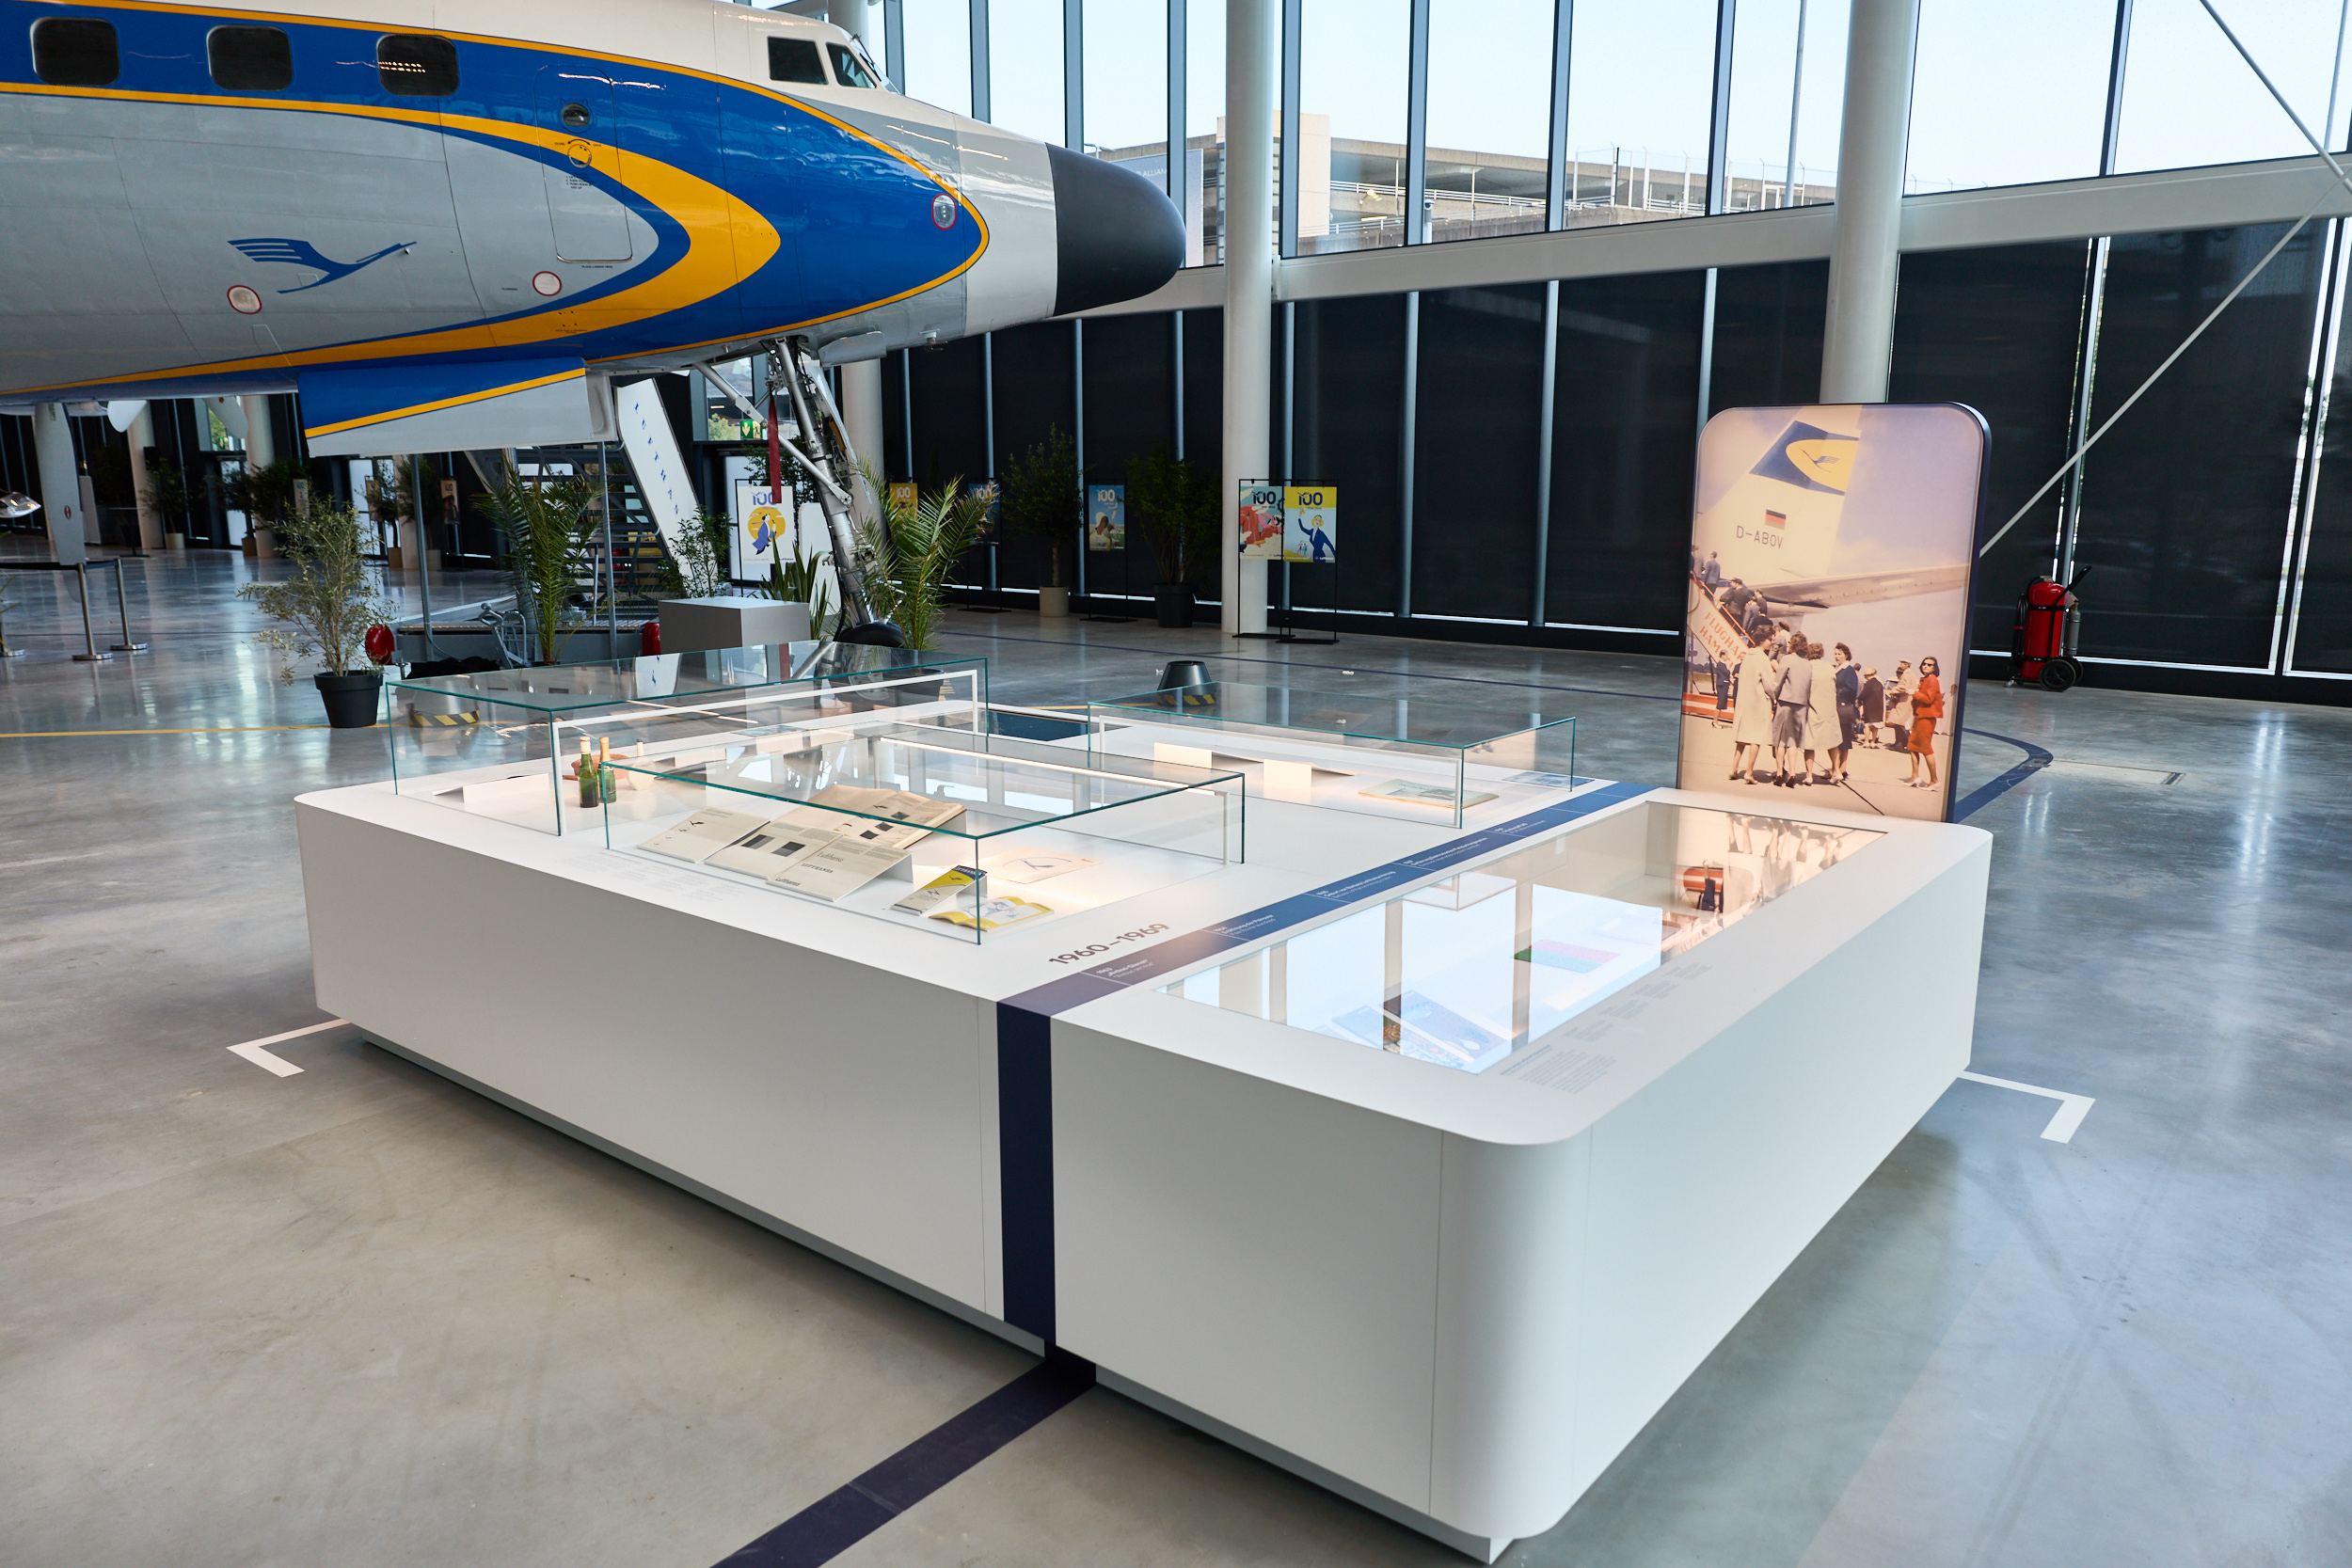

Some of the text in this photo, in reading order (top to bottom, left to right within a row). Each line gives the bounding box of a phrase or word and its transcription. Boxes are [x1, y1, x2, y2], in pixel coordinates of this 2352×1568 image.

[1141, 168, 1168, 177] ALLIAN
[634, 402, 689, 542] LUFTHANS
[896, 486, 911, 499] 100
[1096, 489, 1116, 502] 100
[1252, 490, 1277, 505] 100
[1297, 492, 1324, 506] 100
[1736, 525, 1784, 549] D-ABOV
[1704, 611, 1747, 661] FLUGHAF
